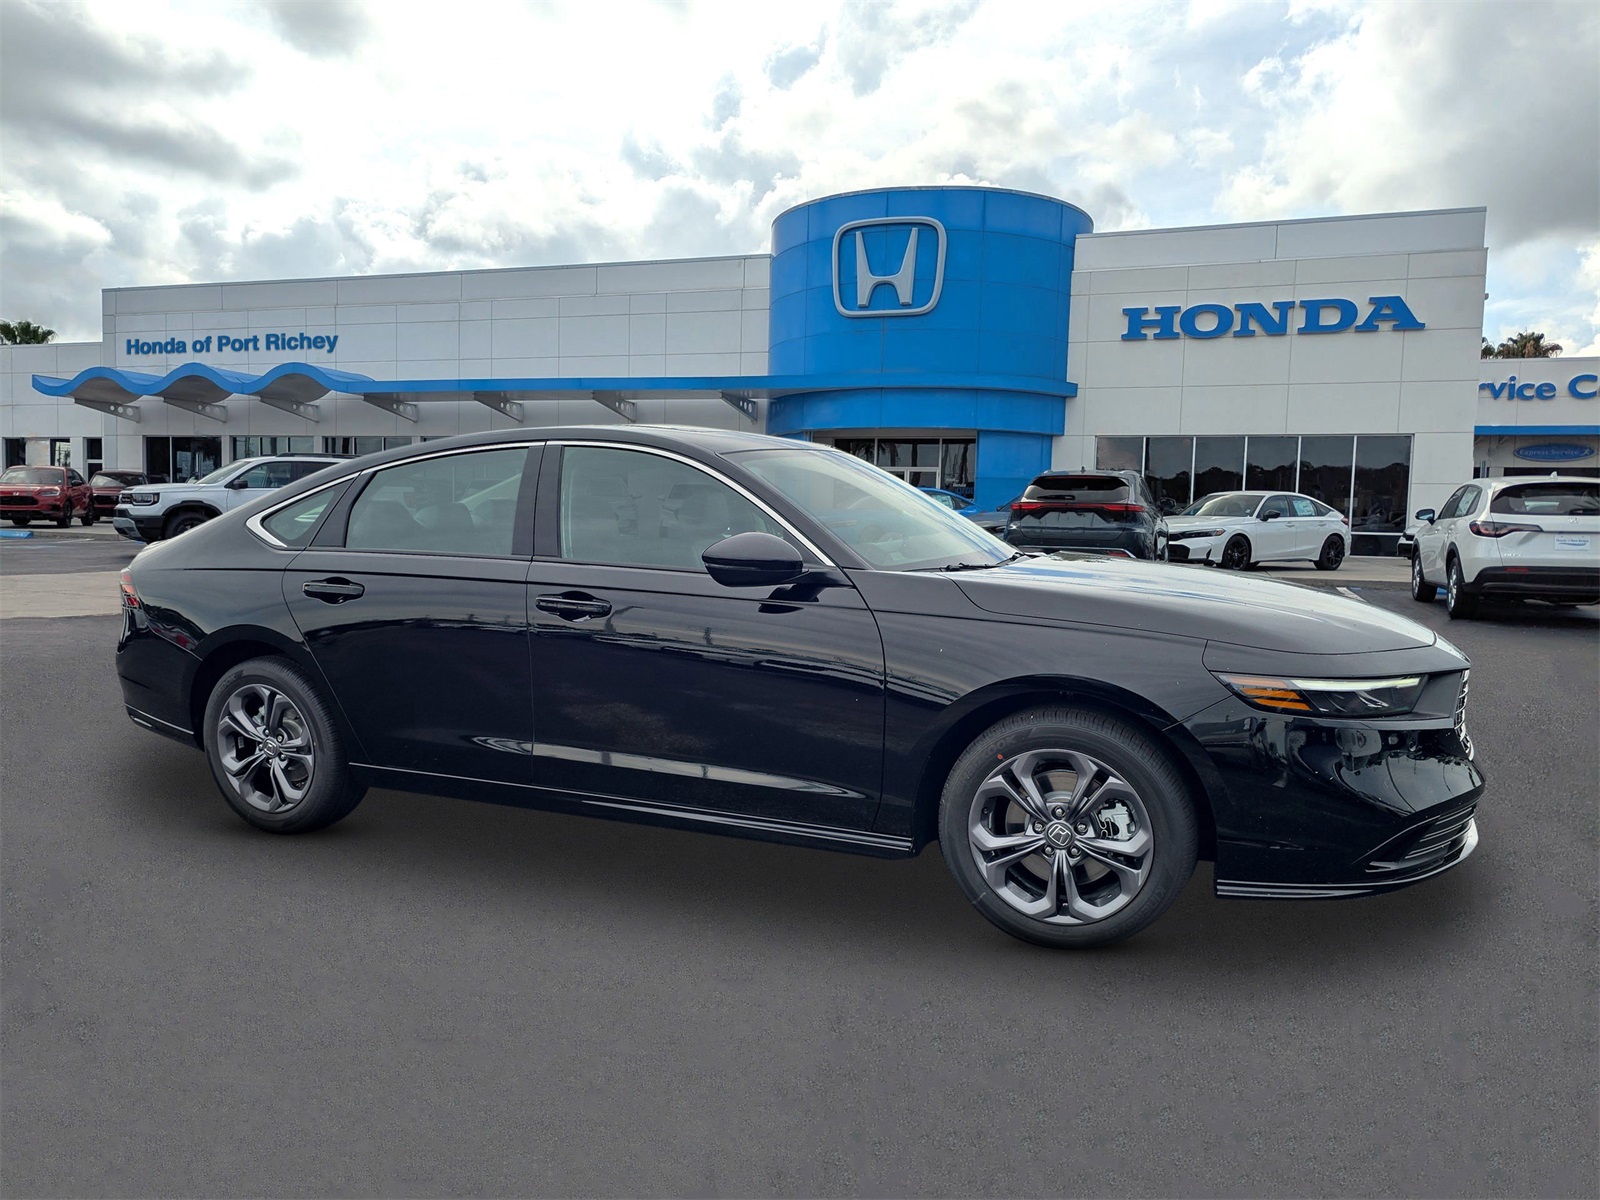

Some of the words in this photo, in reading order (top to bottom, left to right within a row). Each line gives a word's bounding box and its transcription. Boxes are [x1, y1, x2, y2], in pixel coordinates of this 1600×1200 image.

[1121, 296, 1426, 341] HONDA
[126, 337, 187, 355] Honda
[192, 336, 212, 353] of
[217, 335, 259, 352] Port
[265, 333, 339, 354] Richey
[1567, 374, 1600, 400] C
